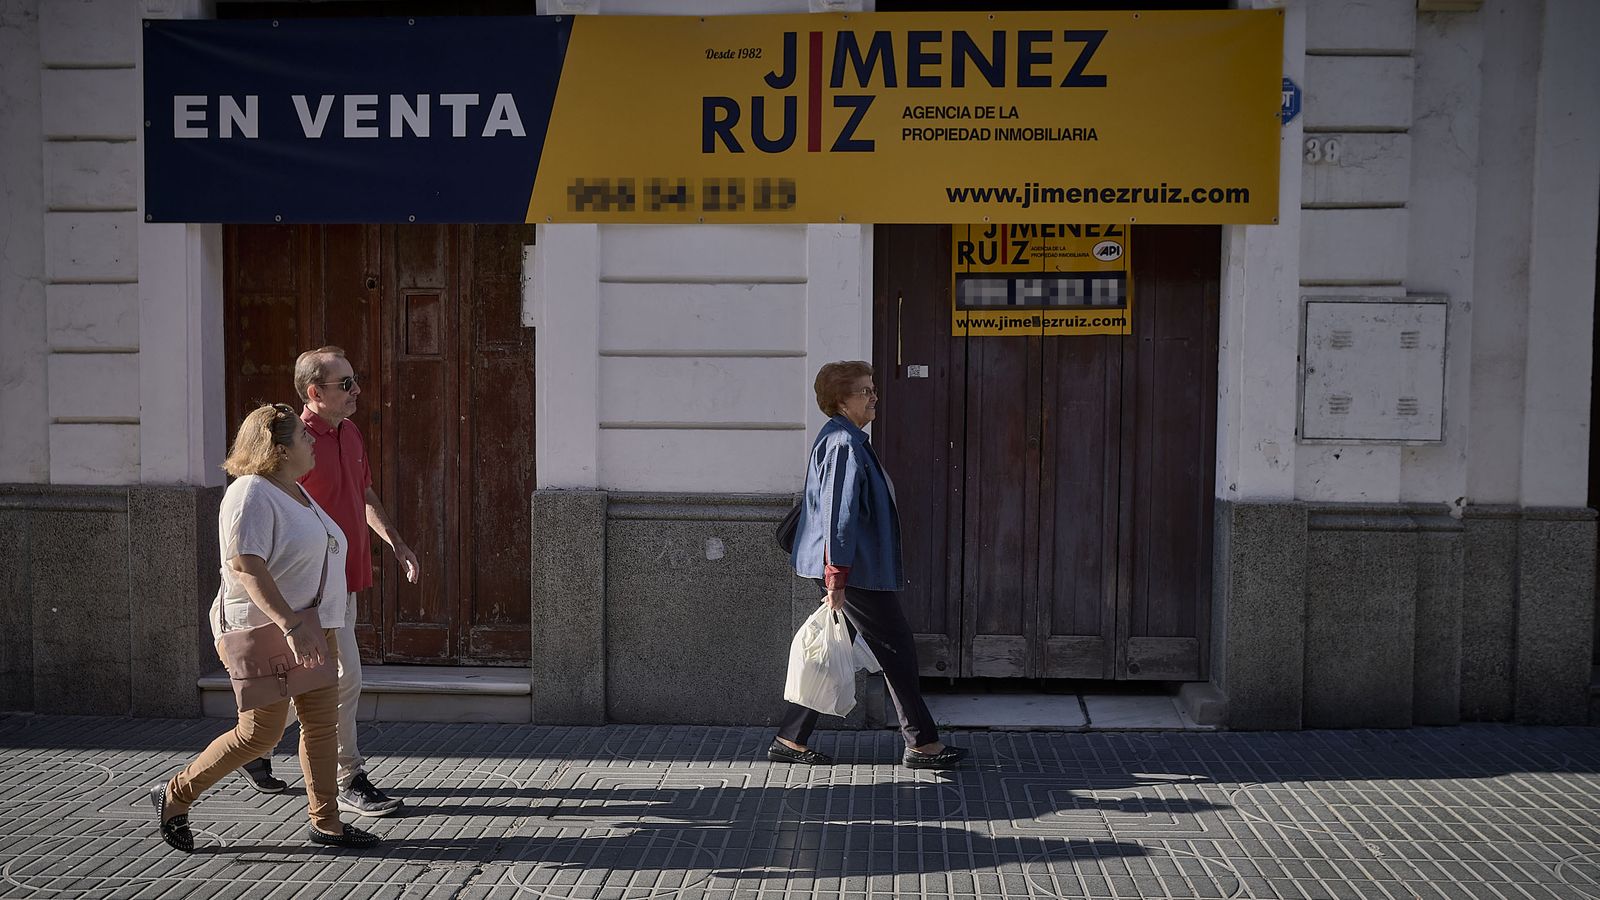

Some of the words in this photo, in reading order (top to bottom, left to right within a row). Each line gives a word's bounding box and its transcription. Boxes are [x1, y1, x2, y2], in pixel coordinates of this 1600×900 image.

[704, 48, 736, 60] Desde
[738, 47, 762, 59] 1982
[763, 29, 1108, 89] JIMENEZ
[173, 95, 259, 138] EN
[291, 93, 527, 138] VENTA
[902, 106, 971, 119] AGENCIA
[974, 106, 995, 119] DE
[999, 106, 1019, 119] LA
[702, 95, 876, 153] RUIZ
[902, 128, 991, 141] PROPIEDAD
[994, 128, 1098, 141] INMOBILIARIA
[946, 182, 1250, 207] www.jimenezruiz.com
[957, 240, 1030, 265] RUIZ
[1098, 246, 1120, 256] API
[956, 315, 1127, 330] www.jimeezruiz.com
